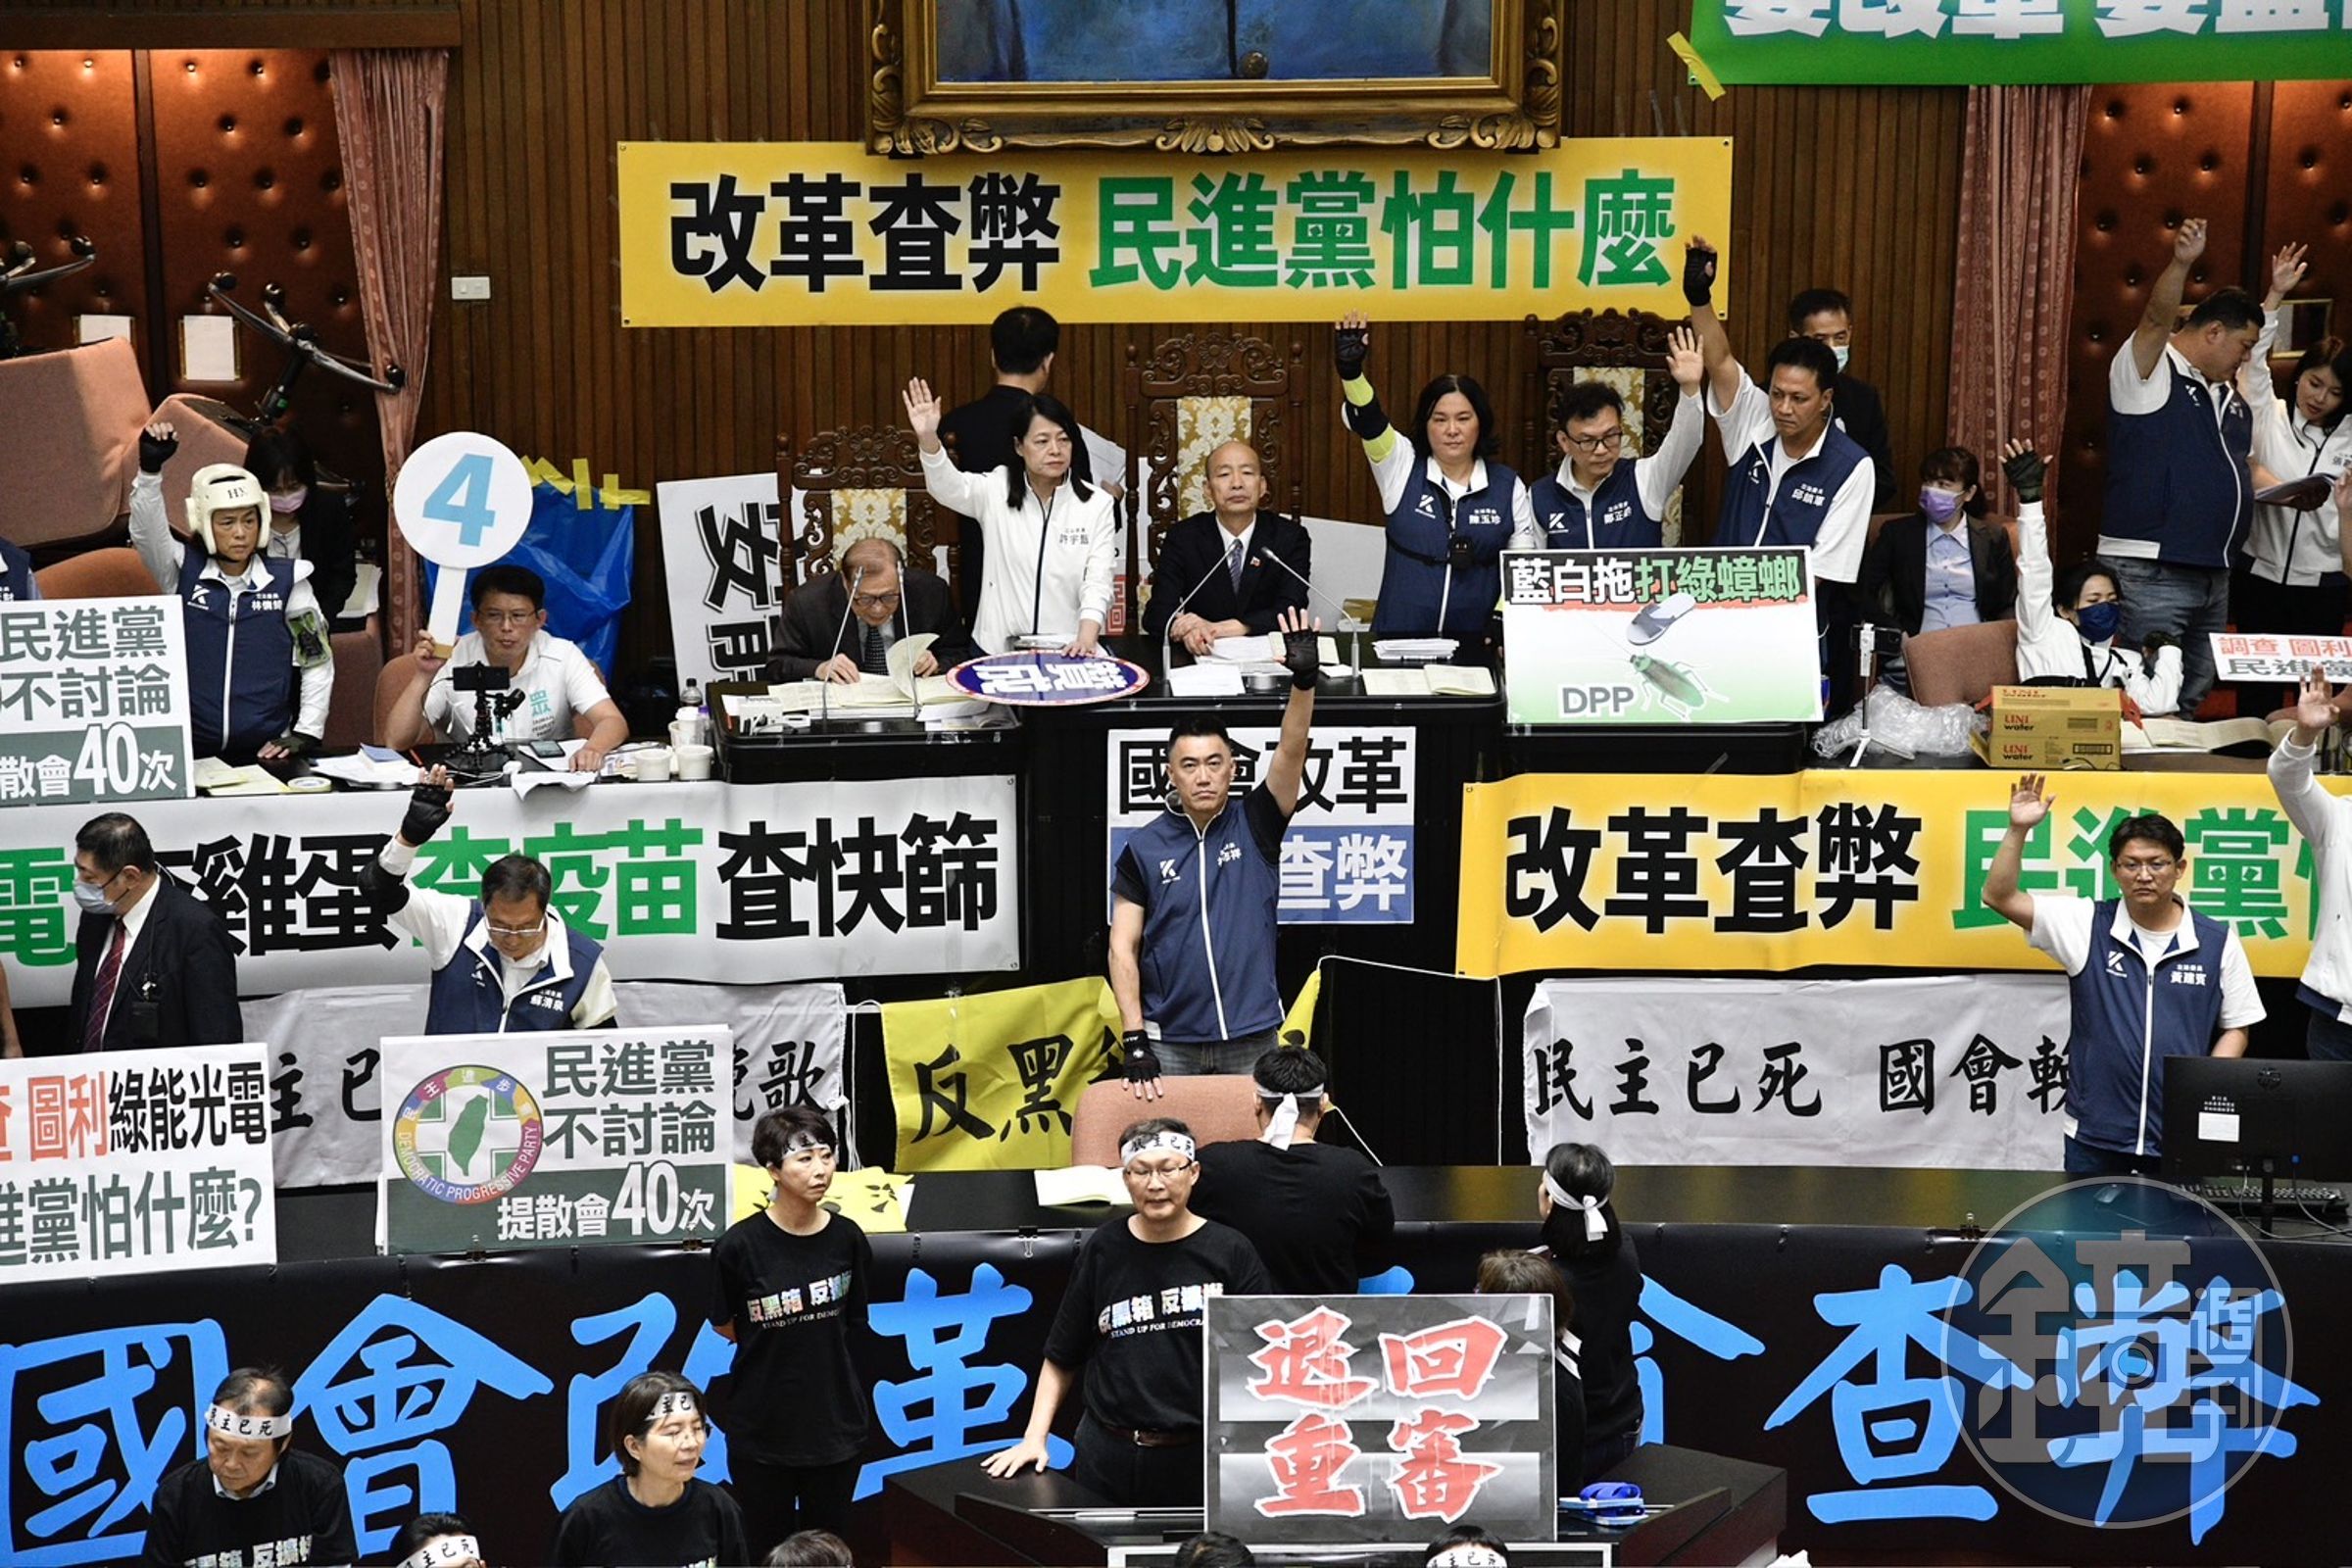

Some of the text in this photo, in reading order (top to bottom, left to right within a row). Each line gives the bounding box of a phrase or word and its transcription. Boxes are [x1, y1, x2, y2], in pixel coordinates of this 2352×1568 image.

[669, 169, 1675, 293] 改革查弊 民進黨怕什麼
[422, 453, 496, 547] 4
[1509, 556, 1802, 605] 藍白拖打綠蟑螂
[0, 605, 168, 662] 民進黨
[2218, 637, 2281, 656] 調查
[0, 662, 172, 721] 不討論
[1561, 686, 1635, 715] DPP
[2004, 714, 2030, 724] UNI
[2003, 745, 2028, 754] UNI
[716, 811, 998, 941] 查快篩
[1506, 803, 1922, 934] 改革查弊
[543, 1039, 716, 1100] 民進黨
[1533, 1037, 1823, 1119] 民主已死
[398, 1126, 539, 1200] DEMOCRATIC PROGRESSIVE PARTY
[542, 1100, 716, 1159] 不討論
[497, 1160, 716, 1242] 提散會40次
[1249, 1306, 1510, 1408] 退回
[1622, 1262, 2322, 1546] 查弊
[1254, 1409, 1504, 1524] 重審
